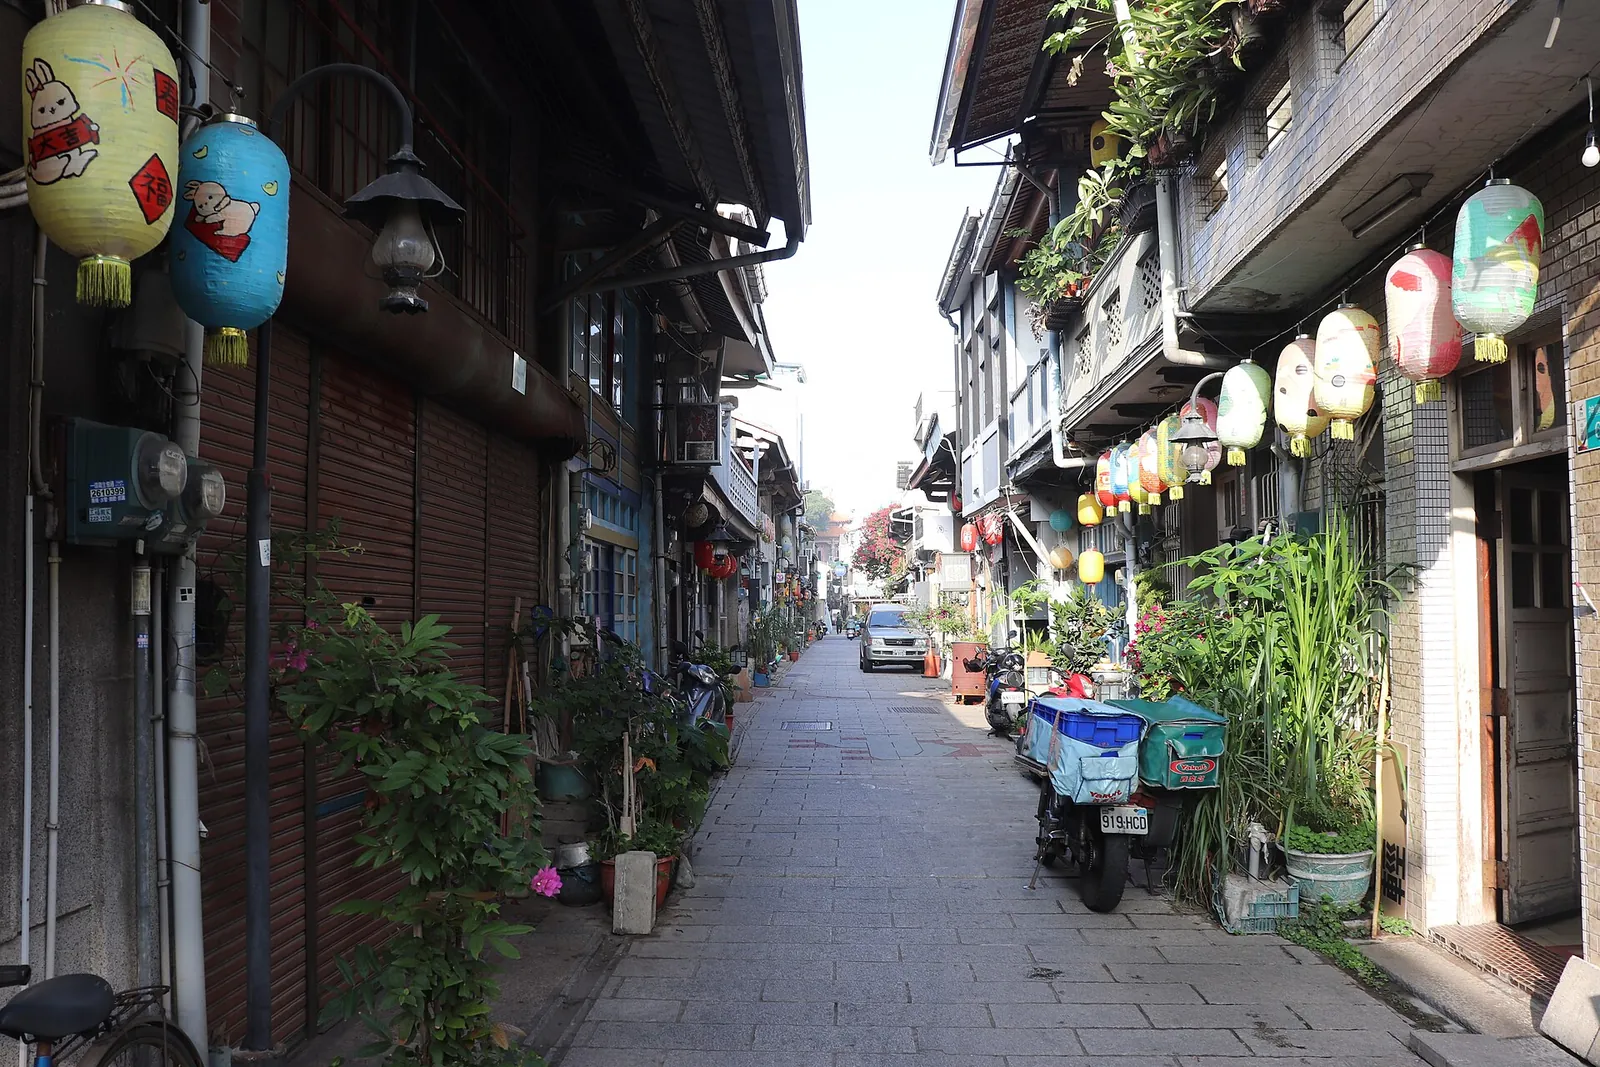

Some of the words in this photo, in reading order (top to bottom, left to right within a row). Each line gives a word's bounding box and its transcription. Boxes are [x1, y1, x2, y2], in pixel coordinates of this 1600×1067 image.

[38, 127, 80, 155] 大吉
[140, 171, 168, 208] 福
[91, 487, 124, 497] 2610399
[1180, 763, 1207, 771] Yakult
[1089, 789, 1123, 799] Yakult
